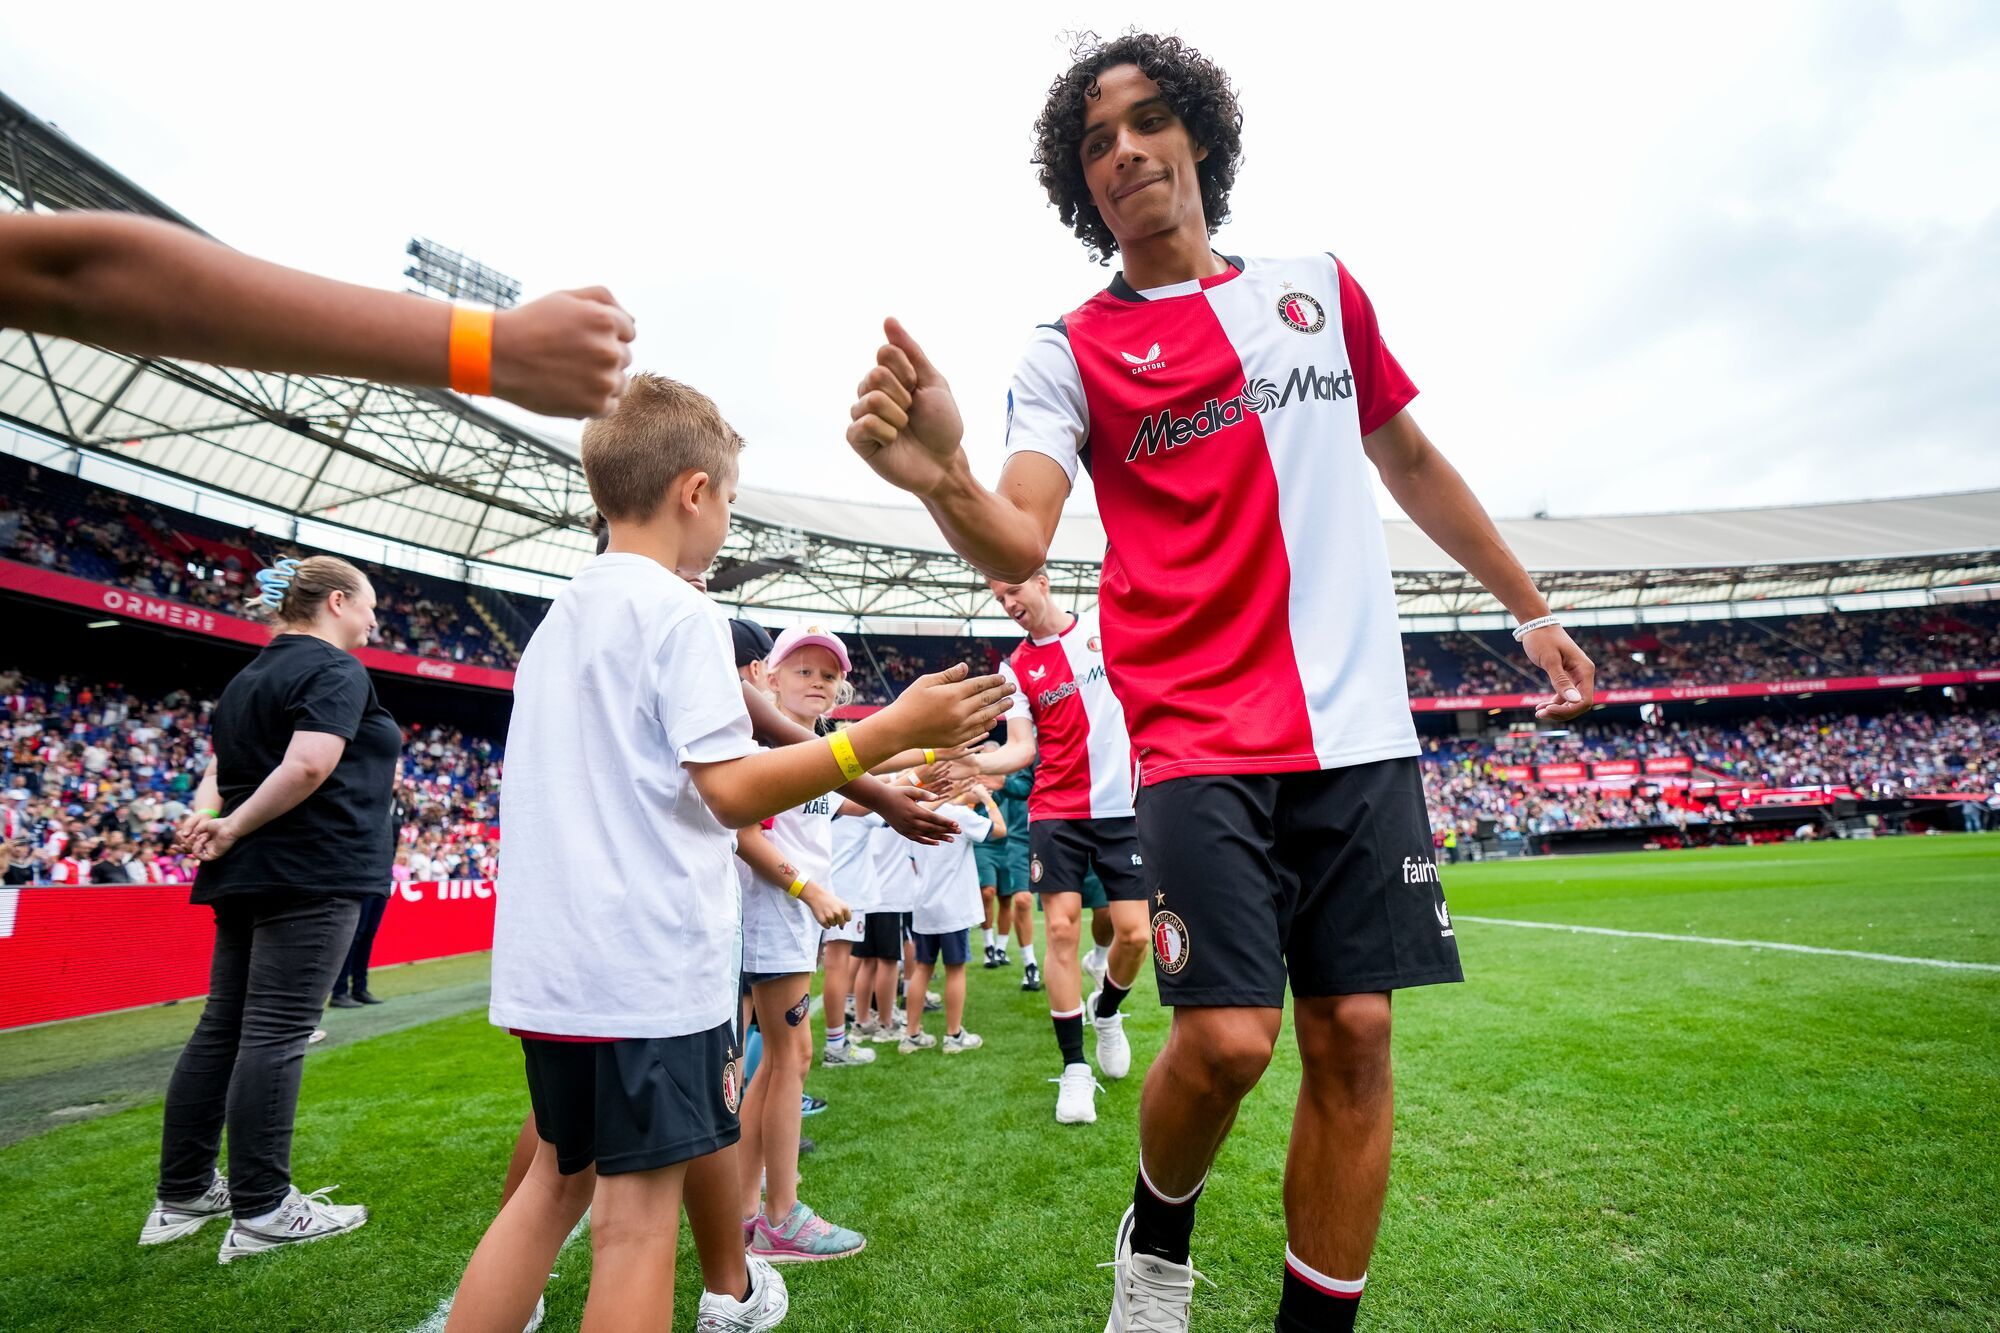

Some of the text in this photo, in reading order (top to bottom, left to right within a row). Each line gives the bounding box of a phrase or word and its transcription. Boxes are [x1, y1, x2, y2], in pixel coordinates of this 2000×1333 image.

[1279, 293, 1318, 310] FEYENOORD
[1285, 315, 1324, 333] ROTTERDAM
[1132, 362, 1166, 375] CASTORE
[1125, 365, 1353, 463] Media Markt
[1039, 681, 1077, 711] Media
